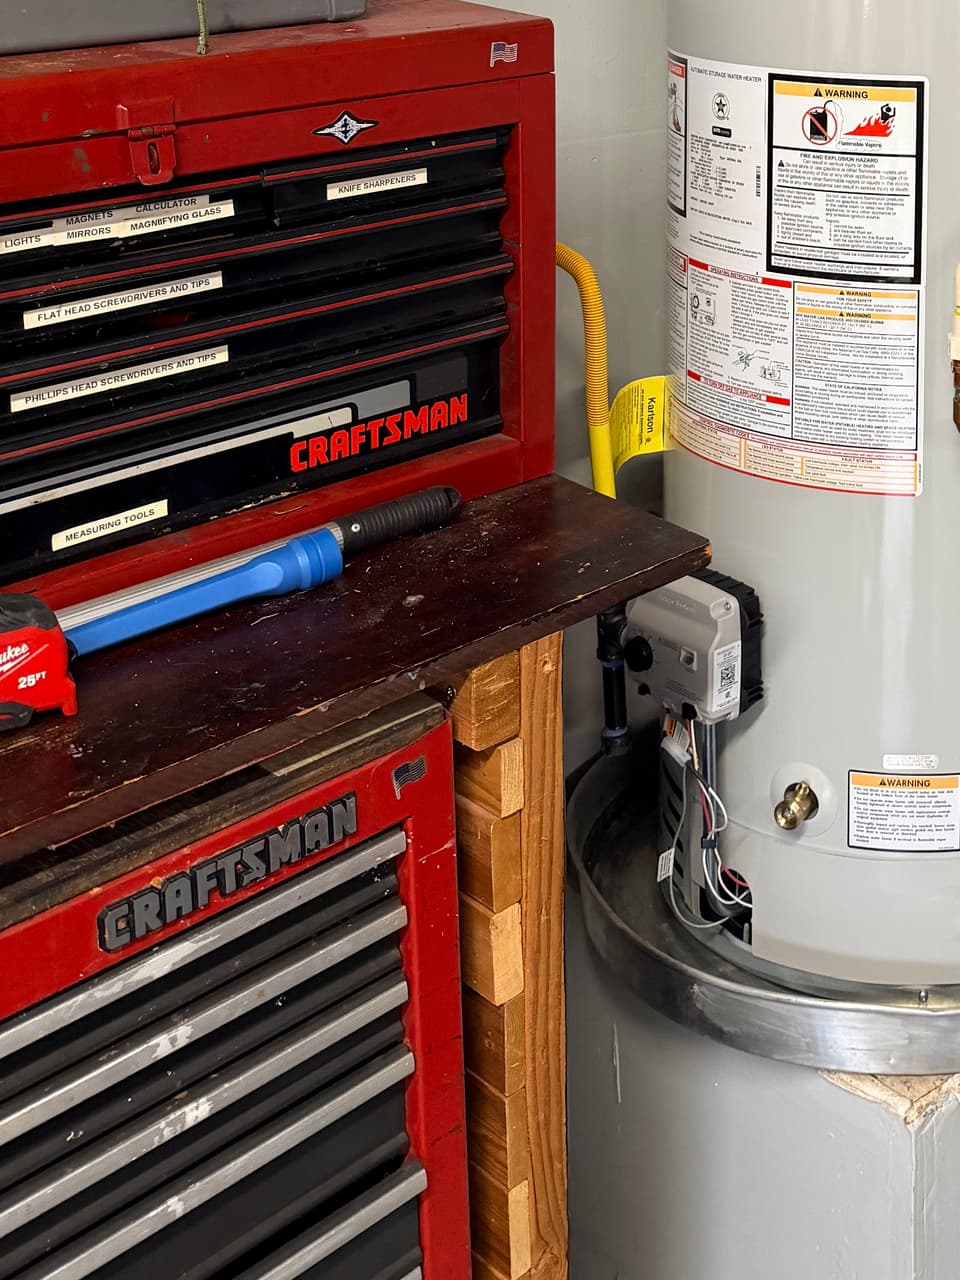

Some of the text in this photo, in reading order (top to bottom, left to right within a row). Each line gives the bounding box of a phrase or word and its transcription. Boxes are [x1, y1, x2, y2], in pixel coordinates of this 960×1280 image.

[709, 70, 726, 78] STORAGE
[825, 88, 868, 99] WARNING
[338, 174, 416, 193] KNIFE SHARPENERS
[4, 234, 41, 248] LIGHTS
[66, 226, 112, 239] MIRRORS
[192, 207, 221, 218] GLASS
[65, 198, 197, 226] MAGNETS CALCULATOR
[37, 278, 210, 321] FLAT HEAD SCREWDRIVERS AND TIPS
[24, 352, 217, 404] PHILLIPS HEAD SCREWDRIVERS AND TIPS
[290, 394, 468, 472] CRAFTSMAN
[65, 508, 155, 542] MEASURING TOOLS
[886, 779, 930, 788] WARNING
[104, 793, 357, 950] CRAFTSMAN
